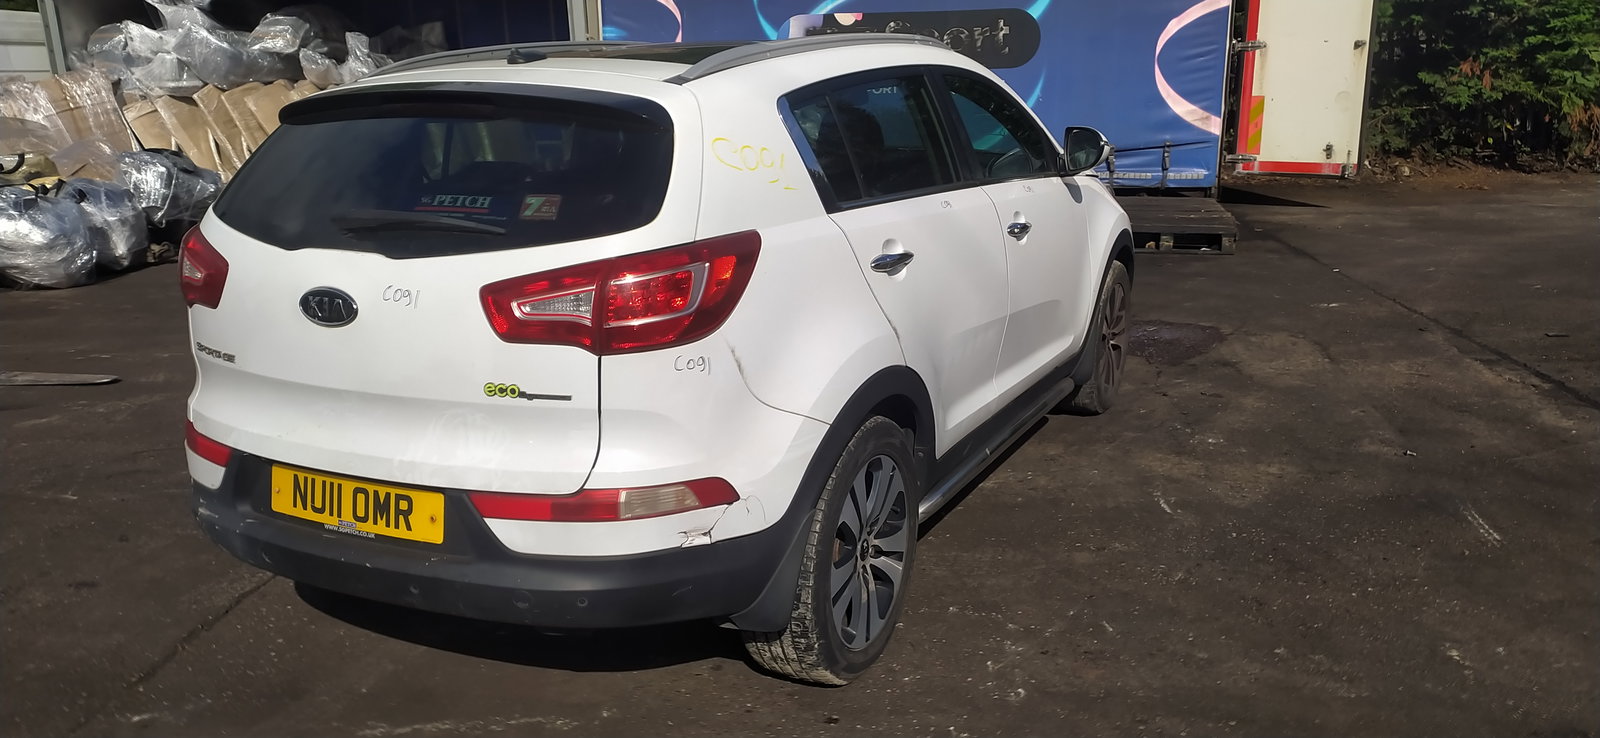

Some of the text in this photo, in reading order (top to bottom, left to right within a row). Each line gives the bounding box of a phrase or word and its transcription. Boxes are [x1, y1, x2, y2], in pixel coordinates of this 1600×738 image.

[432, 194, 493, 208] PETCH
[308, 295, 348, 319] KIA
[382, 284, 420, 309] C091
[674, 354, 711, 376] C091
[484, 382, 520, 398] eco
[293, 473, 414, 532] NU11 OMR
